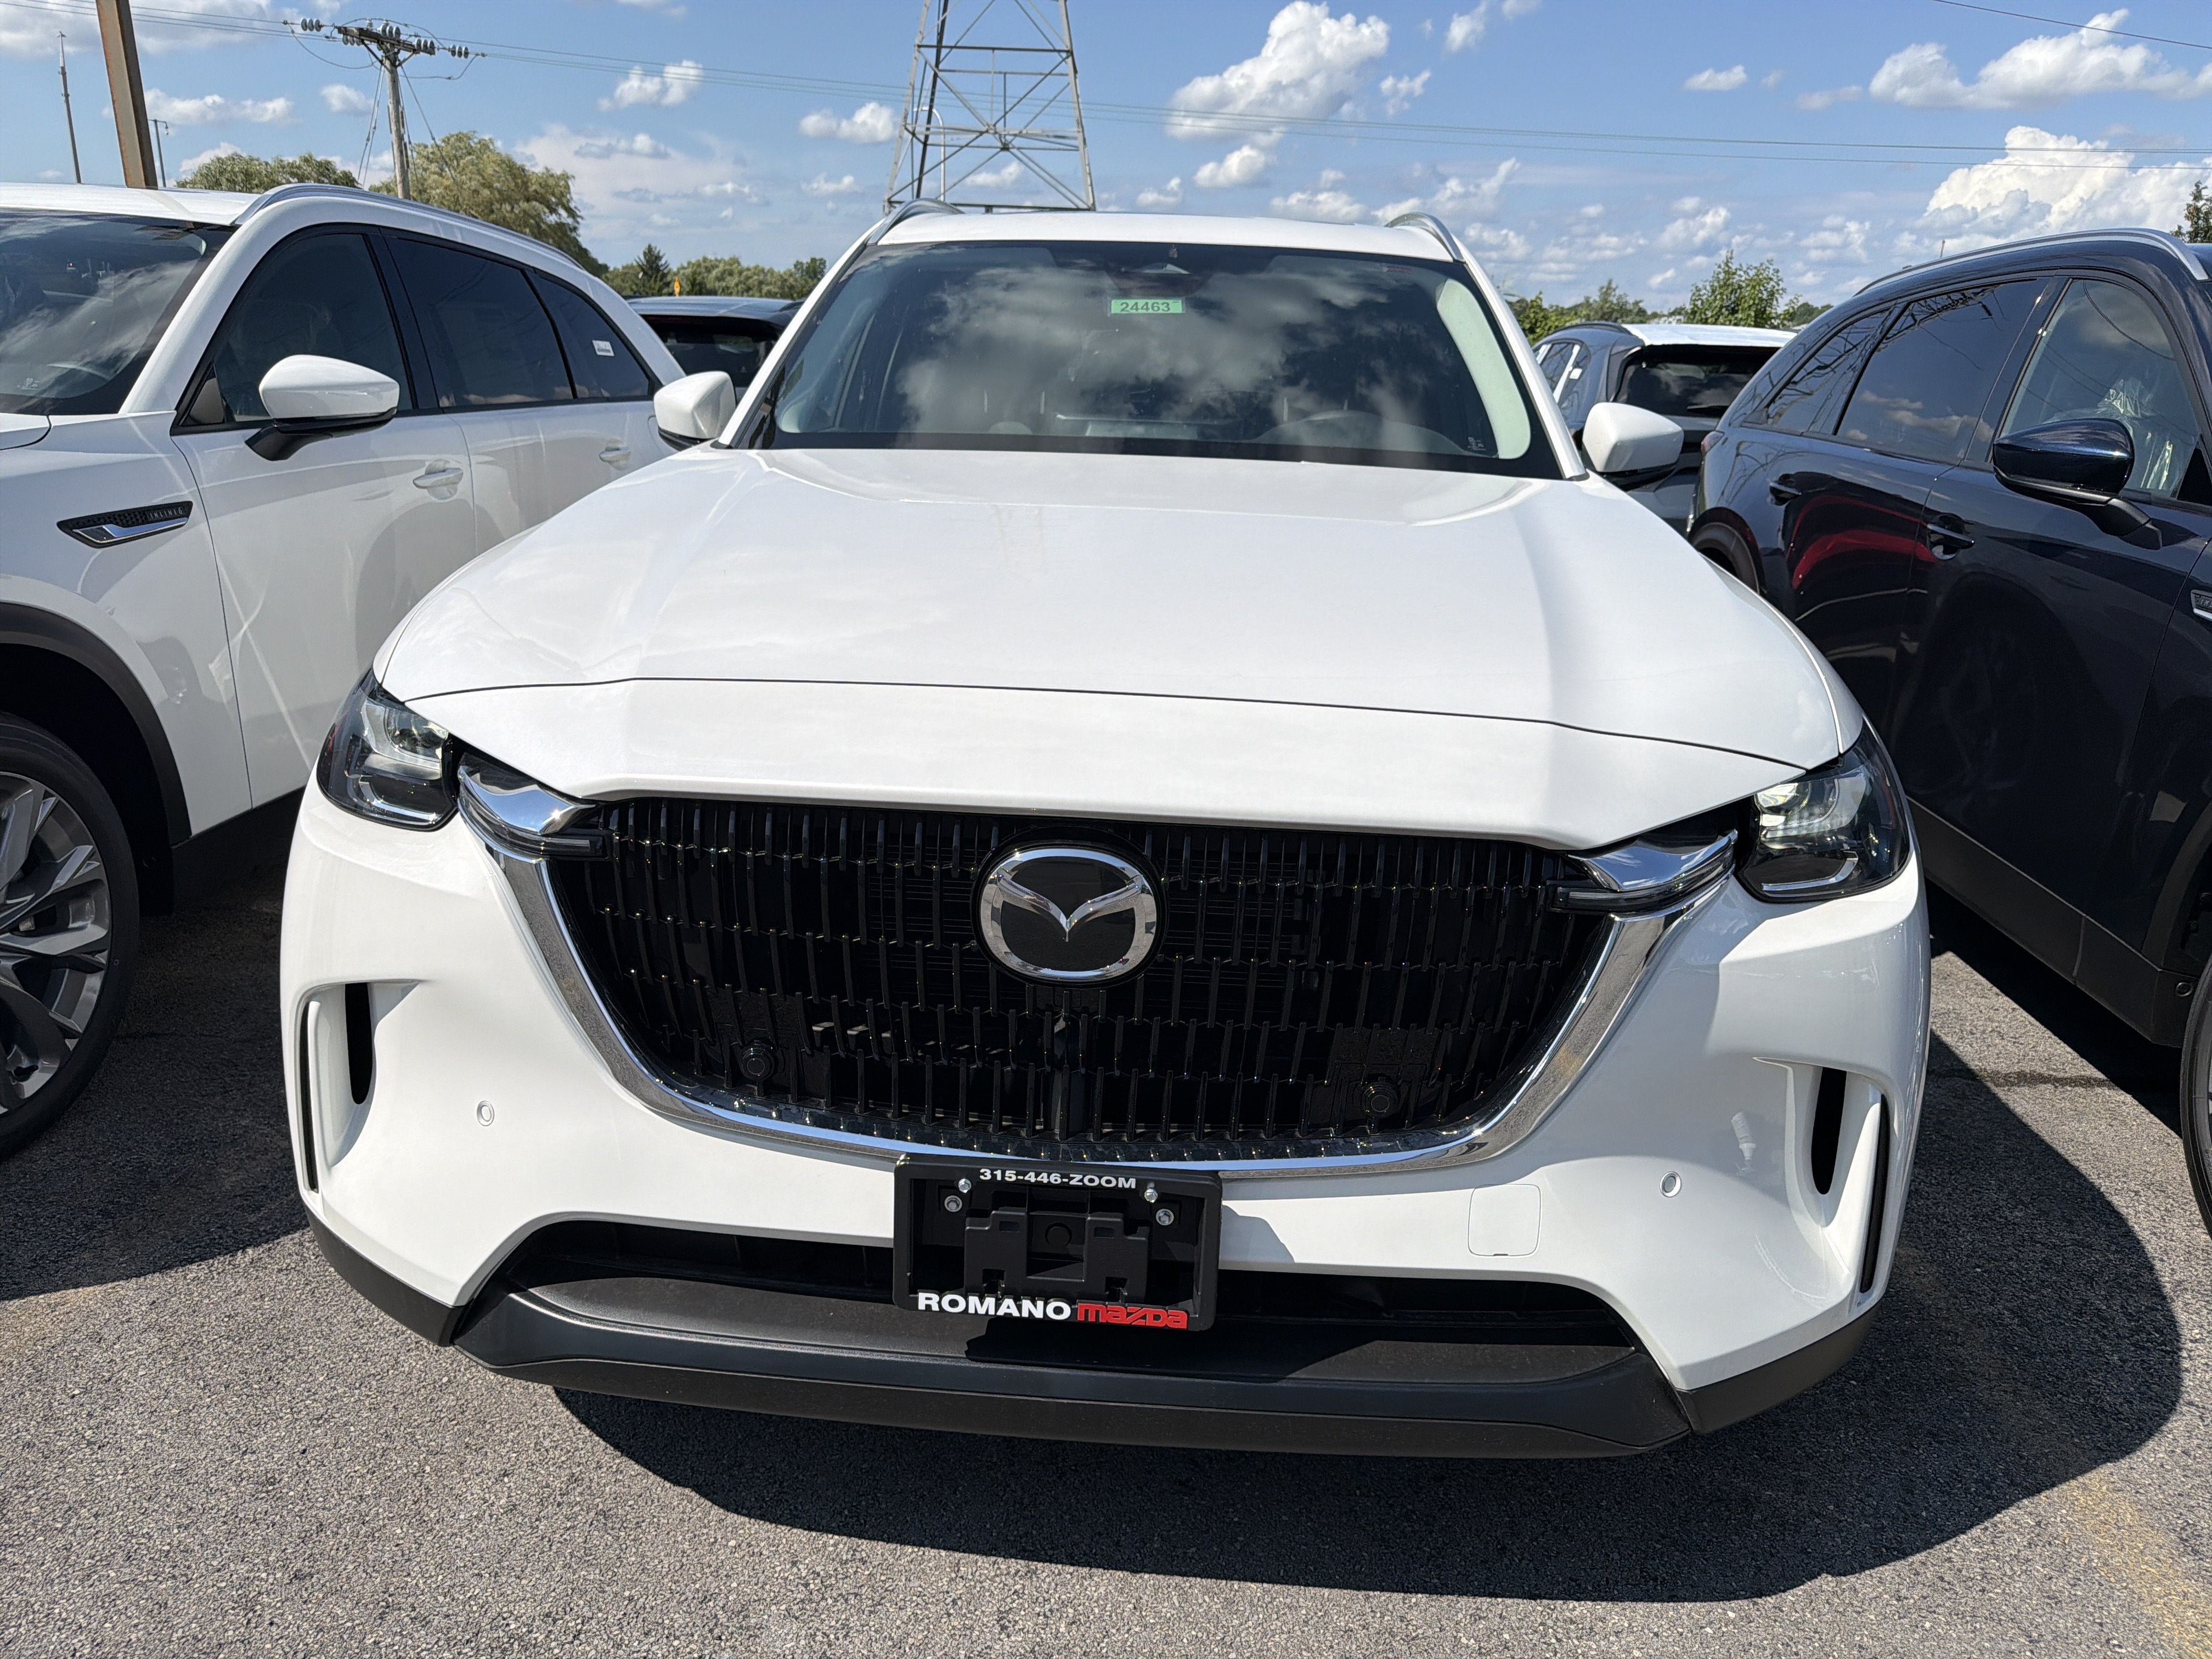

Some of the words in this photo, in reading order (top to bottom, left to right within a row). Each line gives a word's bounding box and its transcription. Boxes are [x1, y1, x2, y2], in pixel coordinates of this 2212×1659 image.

[1120, 302, 1171, 312] 24463
[979, 1168, 1136, 1189] 315-446-ZOOM
[916, 1292, 1071, 1320] ROMANO
